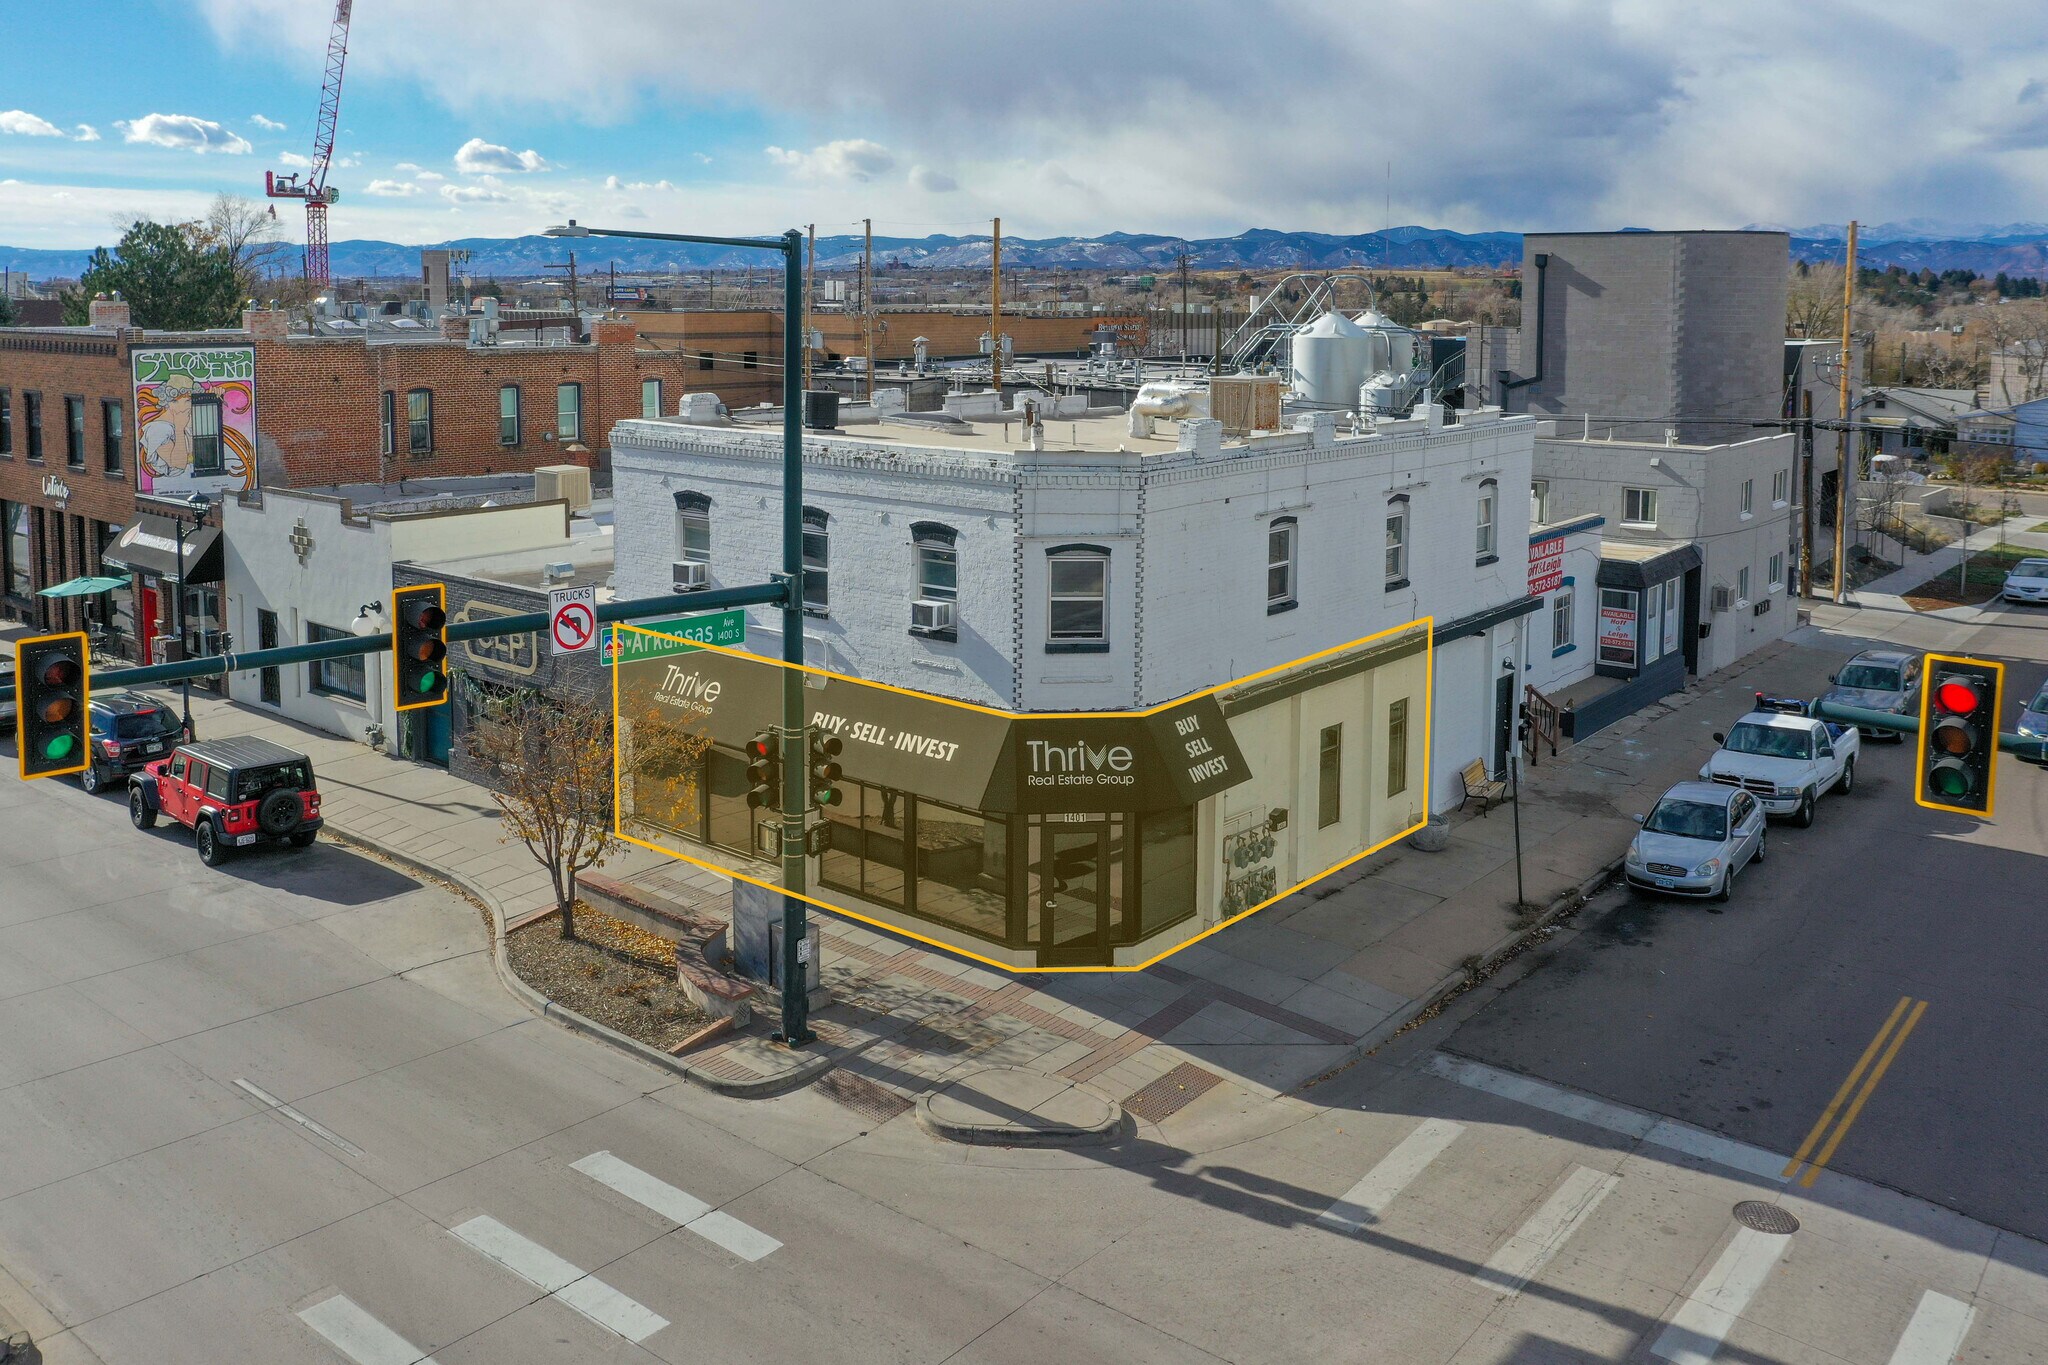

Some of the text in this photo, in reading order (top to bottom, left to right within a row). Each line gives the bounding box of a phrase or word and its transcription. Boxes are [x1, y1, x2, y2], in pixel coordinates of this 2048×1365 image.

[1529, 540, 1563, 560] VAILABLE
[1528, 557, 1562, 577] off&Leigh
[1527, 574, 1562, 595] 0-572-5187
[554, 589, 591, 602] TRUCKS
[723, 616, 735, 628] Ave
[1602, 609, 1636, 620] AVAILABLE
[631, 625, 713, 654] Arkansas
[717, 630, 733, 641] 1400
[735, 628, 740, 638] S
[661, 664, 721, 703] Thrive
[653, 691, 713, 716] Real Estate Group
[1174, 714, 1200, 736] BUY
[811, 711, 960, 762] BUY SELL INVEST
[1026, 740, 1133, 772] Thrive
[1184, 737, 1213, 759] SELL
[1028, 773, 1135, 787] Real Estate Group
[1187, 755, 1228, 784] INVEST
[1064, 812, 1086, 823] 1401
